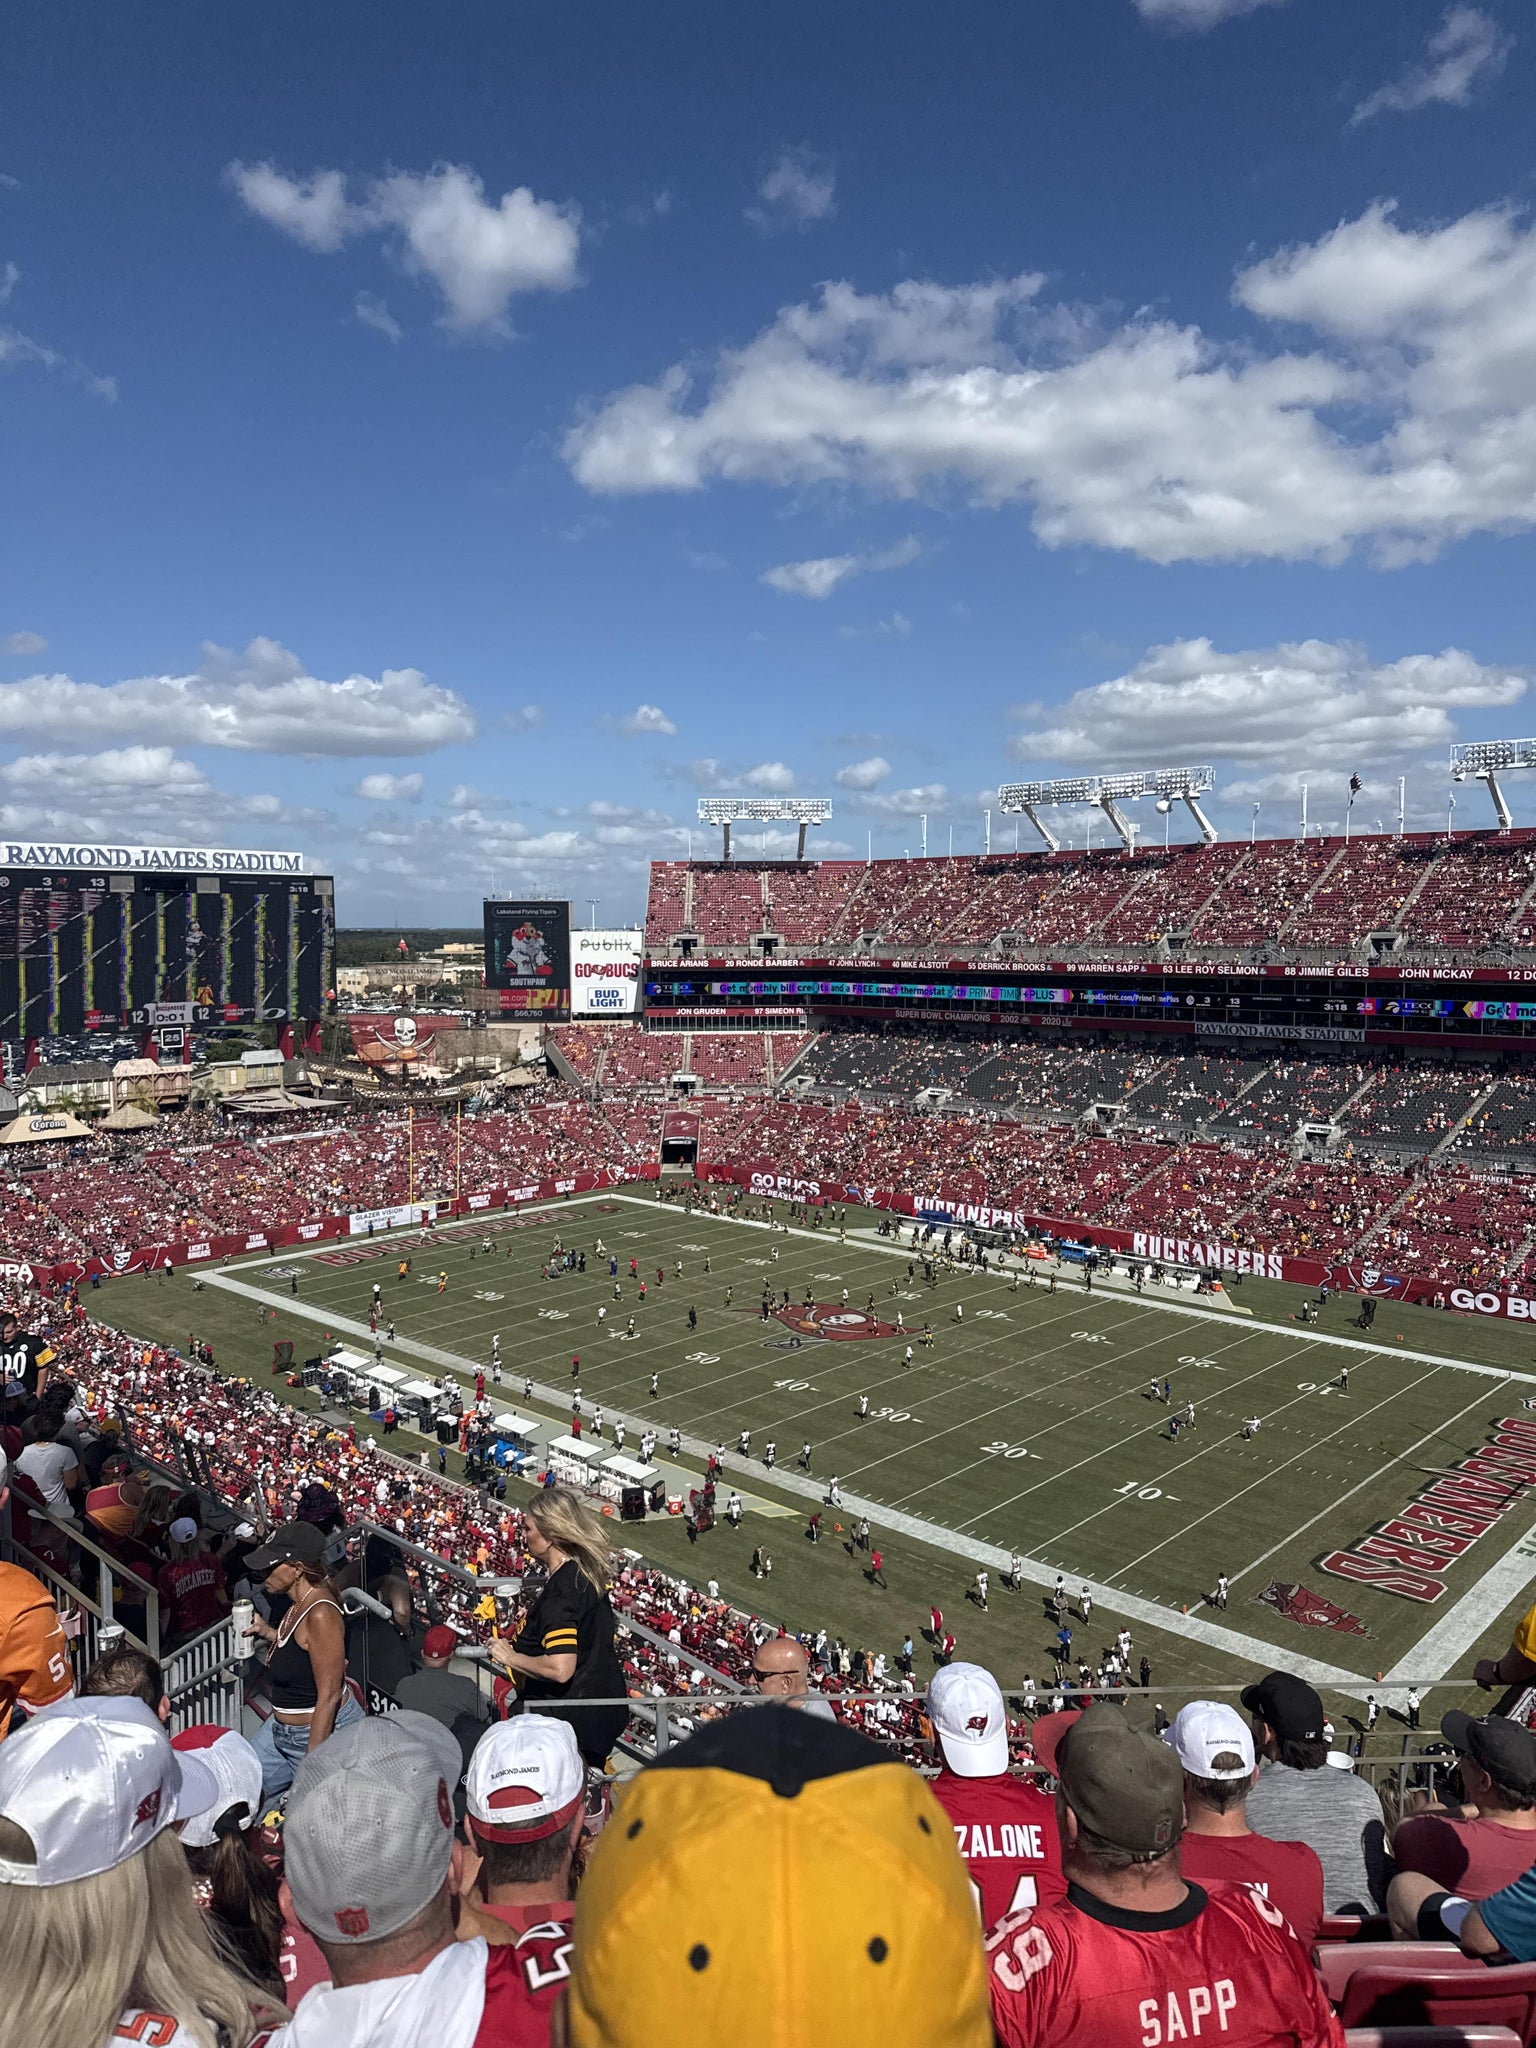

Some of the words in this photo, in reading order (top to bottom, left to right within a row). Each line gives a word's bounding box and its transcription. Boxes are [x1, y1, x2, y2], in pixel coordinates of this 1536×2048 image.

[6, 845, 132, 866] RAYMOND
[134, 849, 207, 868] JAMES
[212, 852, 301, 872] STADIUM
[42, 877, 52, 886] 3
[90, 878, 106, 887] 13
[289, 886, 309, 894] 3:18
[580, 938, 632, 952] Publix
[651, 960, 678, 968] BRUCE
[680, 960, 710, 968] ARIANS
[725, 960, 735, 968] 20
[736, 958, 764, 967] RONDÉ
[855, 960, 876, 968] LYNCH
[918, 961, 950, 969] ALSTOTT
[1066, 964, 1076, 972] 99
[1078, 964, 1114, 972] WARREN
[575, 963, 592, 978] GO
[606, 962, 639, 978] BUCS
[1162, 965, 1174, 973] 63
[1195, 966, 1216, 974] ROY
[1217, 966, 1259, 975] SELMON
[1284, 967, 1296, 976] 88
[1298, 968, 1334, 976] JIMMIE
[1336, 968, 1370, 977] GILES
[1398, 969, 1430, 978] JOHN
[1432, 969, 1474, 979] MCKAY
[1507, 971, 1520, 980] 12
[510, 978, 546, 986] SOUTHPAW
[594, 989, 620, 998] BUD
[720, 984, 736, 992] Get
[780, 984, 794, 992] bill
[831, 984, 844, 992] and
[852, 984, 873, 992] FREE
[876, 985, 898, 994] smart
[900, 985, 945, 996] thermostat
[590, 998, 624, 1008] LIGHT
[1080, 992, 1180, 1004] TampaElectric.com/PrimeTmePlus
[1204, 996, 1210, 1004] 3
[1324, 1002, 1348, 1011] 3:18
[1356, 1002, 1374, 1011] 25
[1486, 1004, 1510, 1016] Get
[131, 1010, 144, 1024] 12
[156, 1012, 186, 1022] 0:01
[198, 1007, 210, 1020] 12
[896, 1010, 920, 1018] SUPER
[921, 1011, 943, 1020] BOWL
[944, 1012, 991, 1022] CHAMPIONS
[1000, 1016, 1019, 1024] 2002
[1041, 1016, 1061, 1026] 2020
[164, 1033, 180, 1042] 25
[1195, 1024, 1260, 1036] RAYMOND
[1260, 1026, 1302, 1038] JAMES
[1304, 1028, 1363, 1042] STADIUM
[30, 1120, 66, 1132] Corona
[751, 1172, 775, 1188] GO
[355, 1211, 381, 1221] GLAZER
[382, 1208, 404, 1216] VISION
[248, 1233, 264, 1242] TEAM
[1133, 1232, 1283, 1280] BUCCANEERS
[1450, 1288, 1501, 1314] GO
[538, 1310, 570, 1320] 30
[684, 1352, 721, 1365] 50
[1177, 1355, 1218, 1368] 20
[772, 1378, 811, 1392] 40
[870, 1406, 911, 1423] 30
[980, 1441, 1028, 1459] 20
[1112, 1480, 1163, 1500] 10
[48, 1652, 66, 1684] 5
[519, 1766, 540, 1774] JAMES
[1138, 1978, 1237, 2048] SAPP
